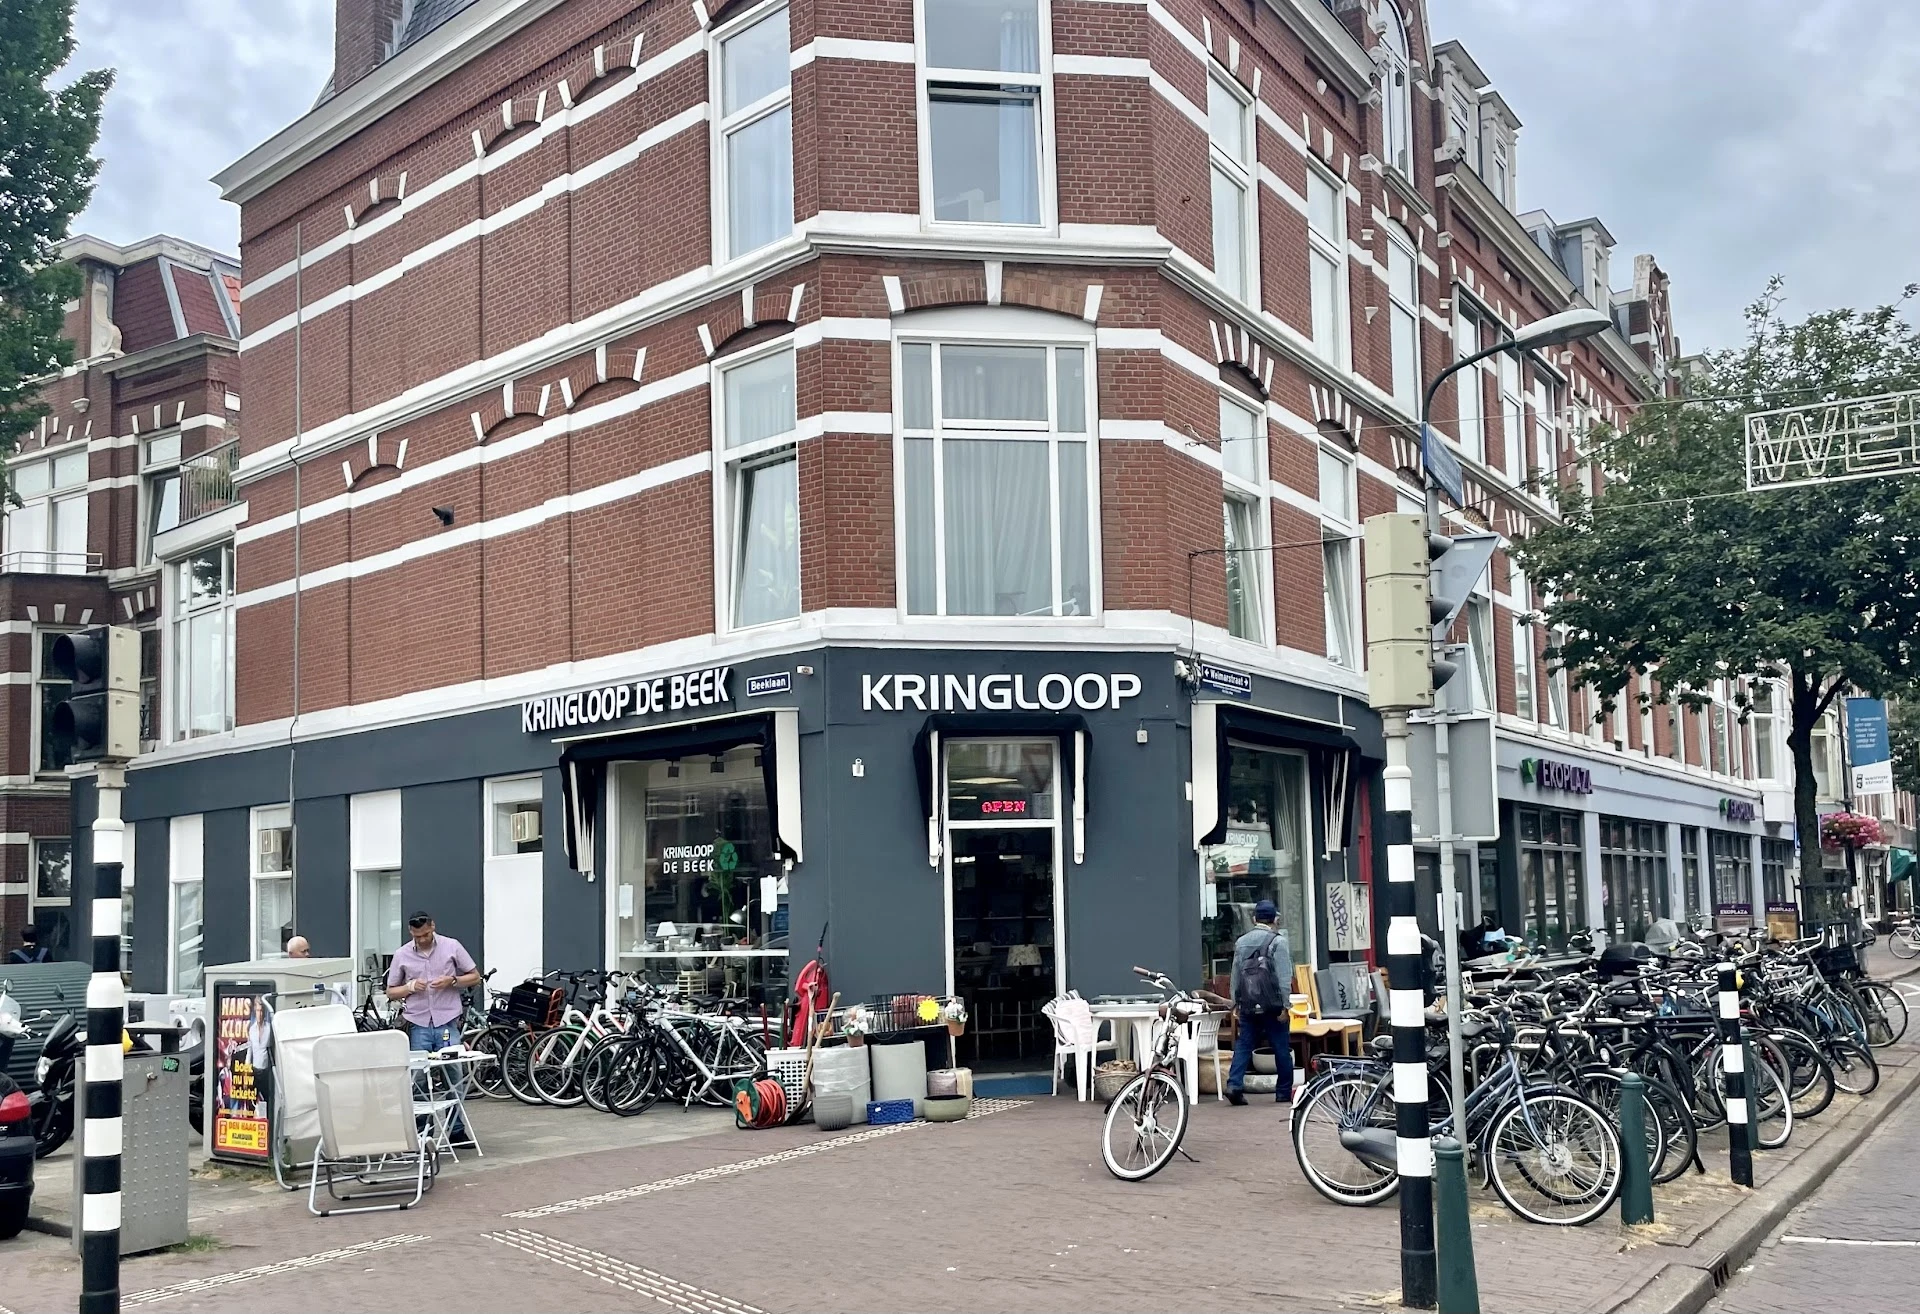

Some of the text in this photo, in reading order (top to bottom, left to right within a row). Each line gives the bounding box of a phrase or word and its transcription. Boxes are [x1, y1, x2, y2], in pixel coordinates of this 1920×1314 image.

[1751, 396, 1920, 481] WE
[750, 678, 786, 690] Beeklaan
[861, 673, 1142, 711] KRINGLOOP
[522, 667, 730, 733] KRINGLOOP DE BEEK
[1541, 759, 1592, 794] EKOPLAZA
[981, 801, 1026, 813] OPEN
[663, 845, 714, 859] KRINGLOOP
[663, 860, 714, 874] DE BEEK
[221, 998, 251, 1016] HANS
[221, 1020, 250, 1038] KLOK
[234, 1060, 253, 1073] Boek
[233, 1075, 242, 1084] nu
[230, 1087, 257, 1101] tickets!
[229, 1122, 239, 1130] DEN
[241, 1122, 256, 1131] HAAG
